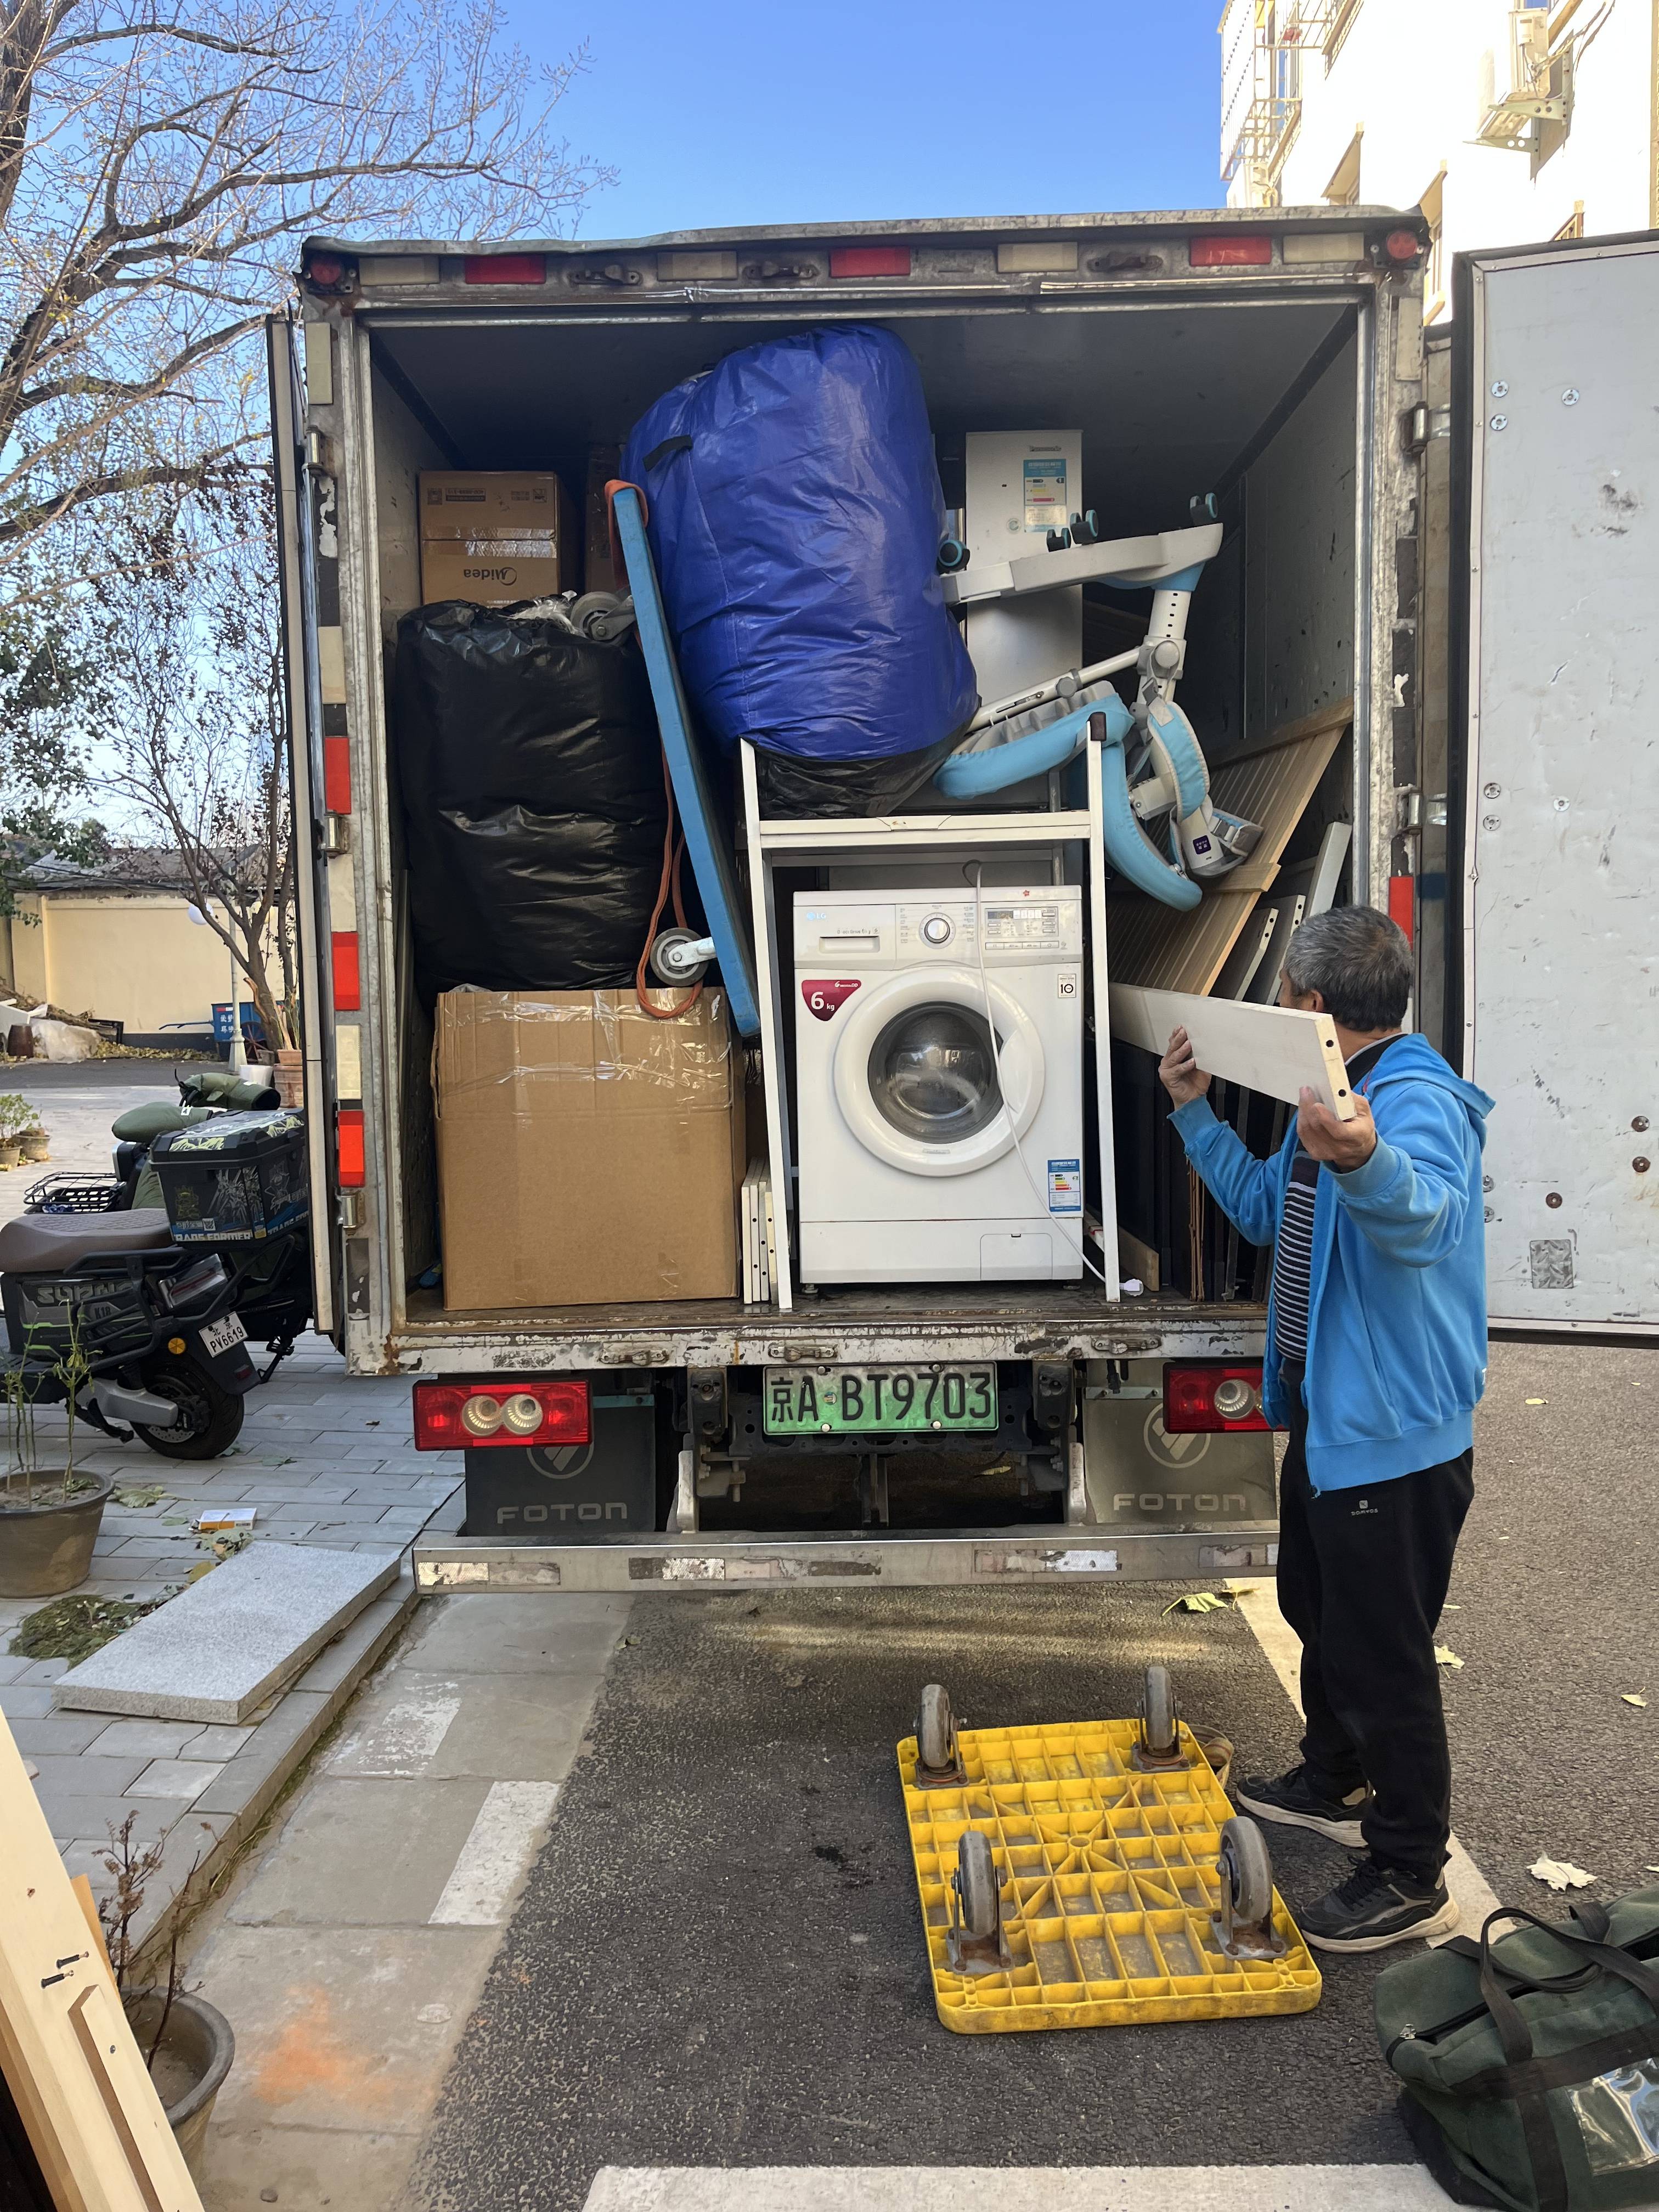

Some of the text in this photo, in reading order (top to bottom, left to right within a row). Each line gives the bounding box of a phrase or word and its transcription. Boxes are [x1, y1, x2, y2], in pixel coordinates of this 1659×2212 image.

[464, 567, 516, 585] Midea
[811, 991, 825, 1010] 6
[210, 1326, 244, 1353] PV6619
[842, 1372, 991, 1421] BT9703
[1113, 1493, 1246, 1511] FOTON
[496, 1502, 628, 1524] FOTON
